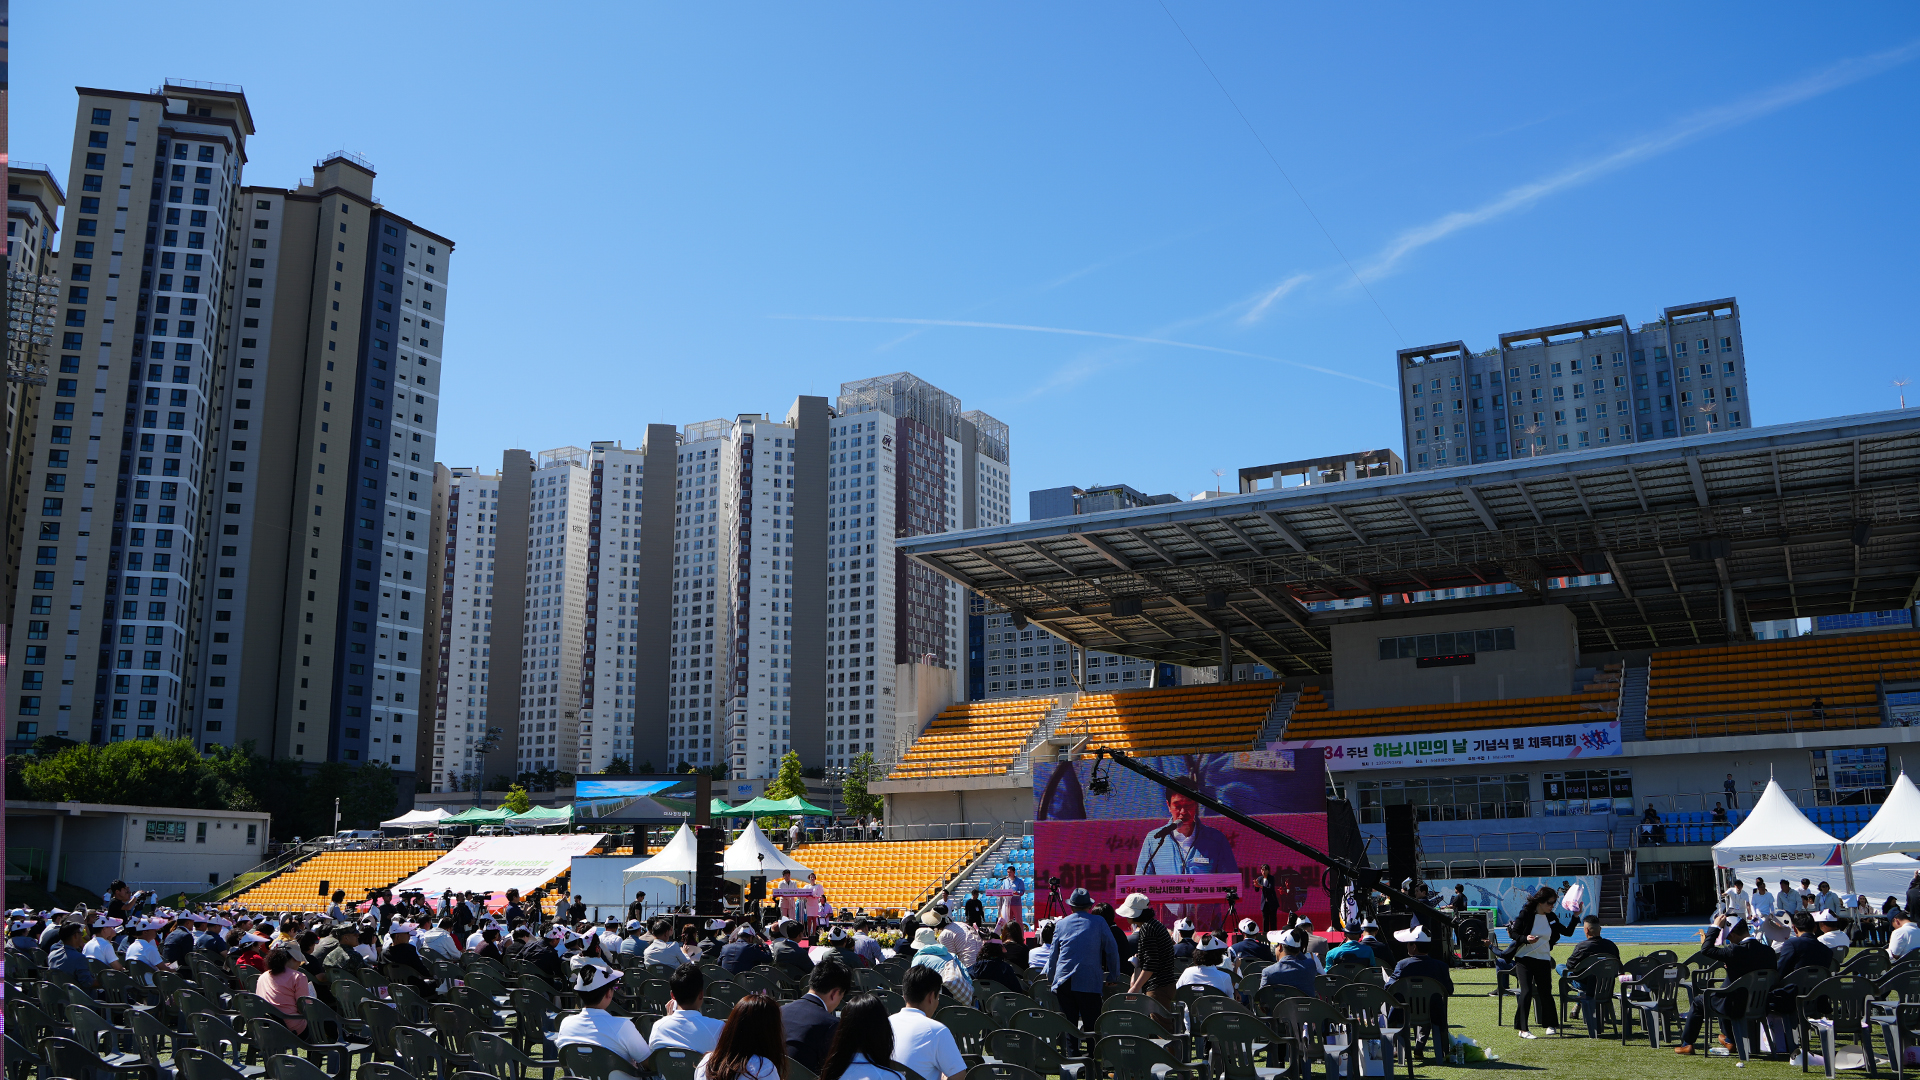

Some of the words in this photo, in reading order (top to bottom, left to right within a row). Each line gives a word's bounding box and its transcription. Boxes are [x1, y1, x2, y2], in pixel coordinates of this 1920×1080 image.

[1373, 739, 1448, 757] 하남시민의
[1452, 738, 1468, 754] 날
[1473, 738, 1509, 752] 기념식
[1512, 737, 1525, 750] 및
[1527, 734, 1576, 749] 체육대회
